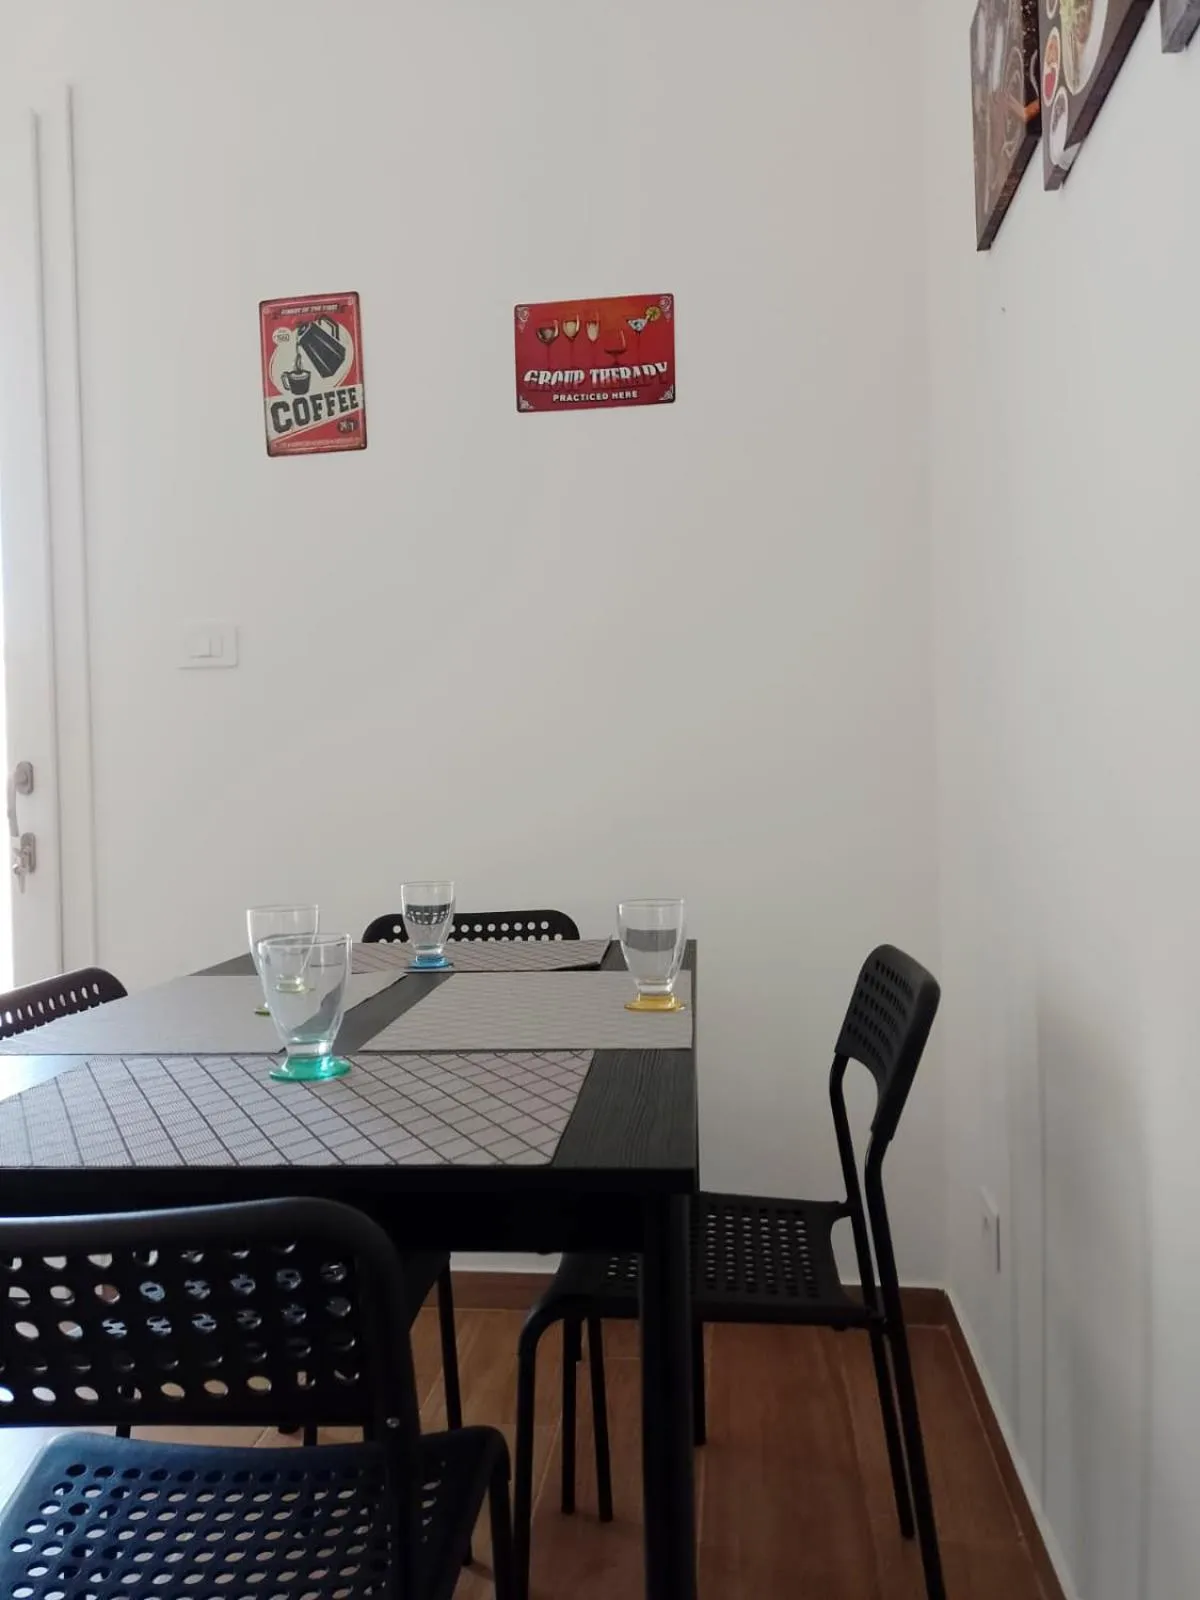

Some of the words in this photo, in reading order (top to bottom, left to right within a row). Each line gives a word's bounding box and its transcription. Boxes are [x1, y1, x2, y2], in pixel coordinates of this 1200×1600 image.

[270, 387, 359, 433] COFFEE
[553, 393, 609, 402] PRACTICED
[612, 390, 638, 399] HERE
